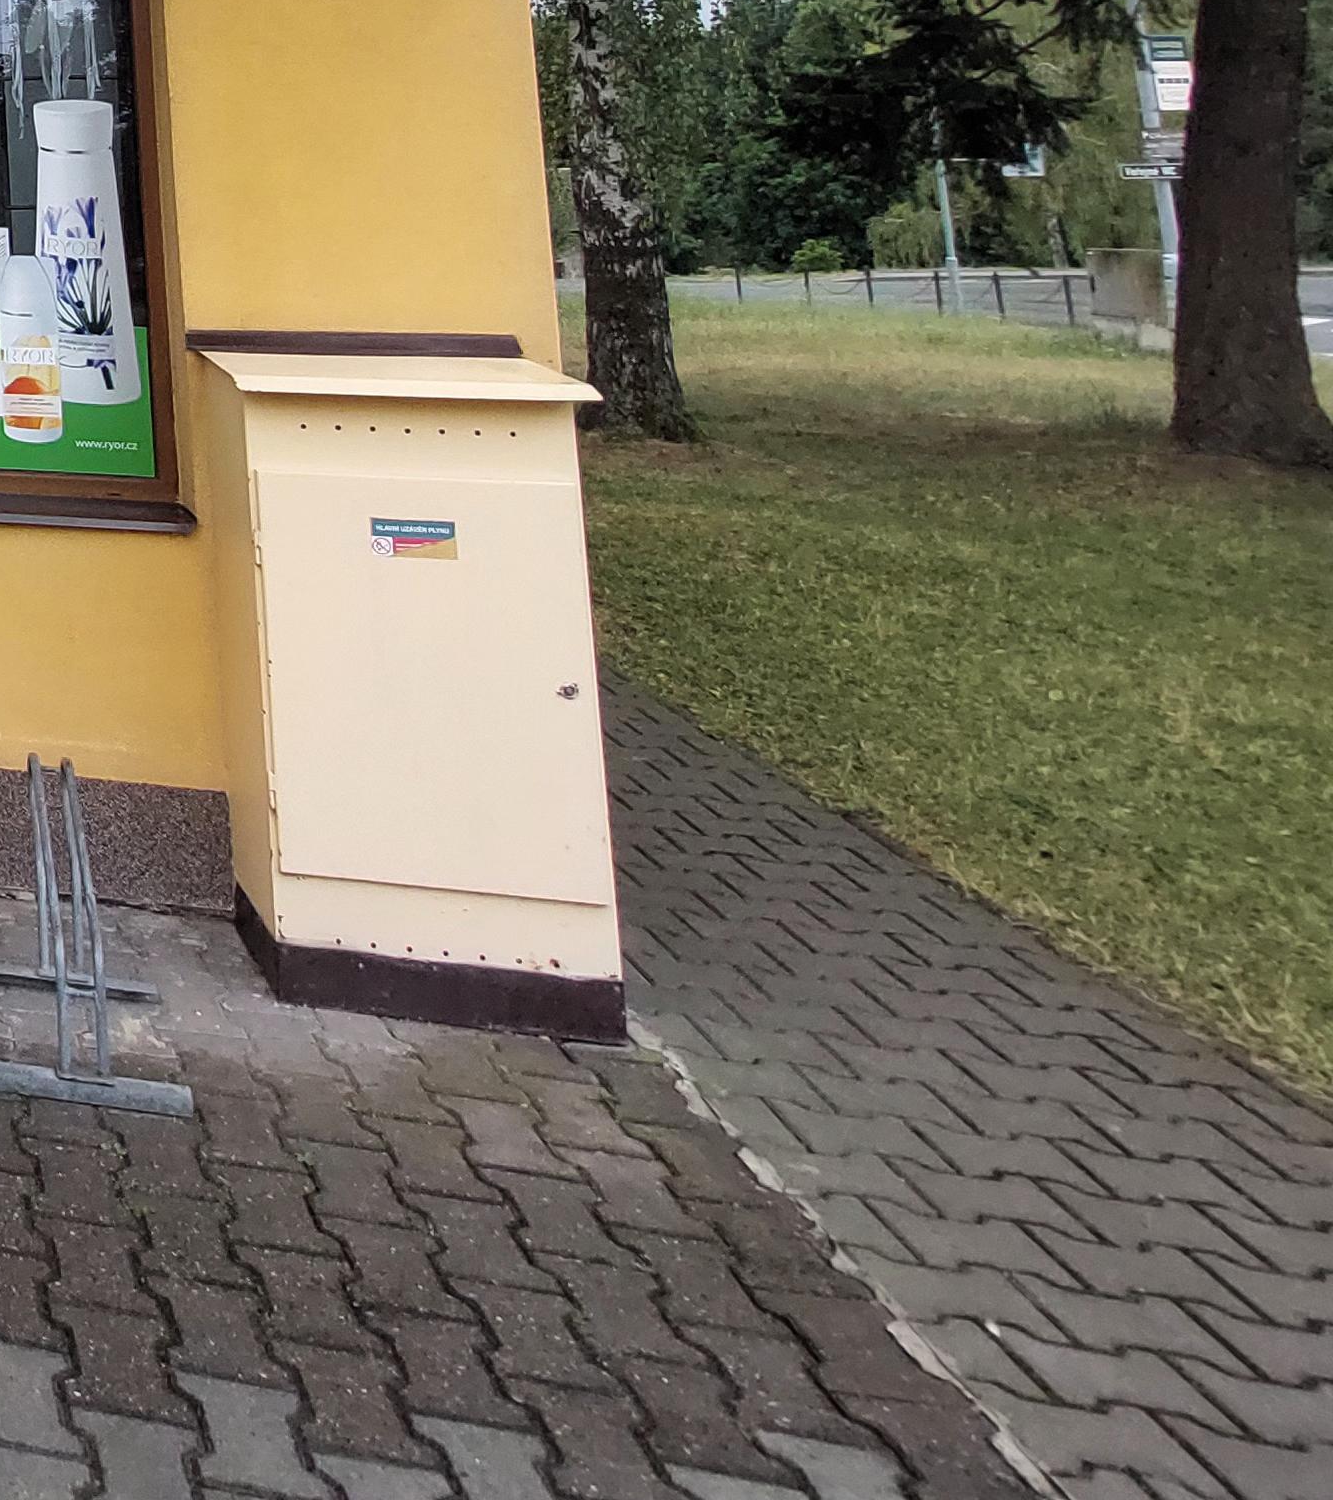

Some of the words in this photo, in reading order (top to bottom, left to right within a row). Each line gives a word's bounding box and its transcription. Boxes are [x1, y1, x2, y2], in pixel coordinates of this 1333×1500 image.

[47, 238, 100, 255] RYOR
[5, 348, 53, 363] RYOR
[74, 440, 138, 451] www.ryor.cz
